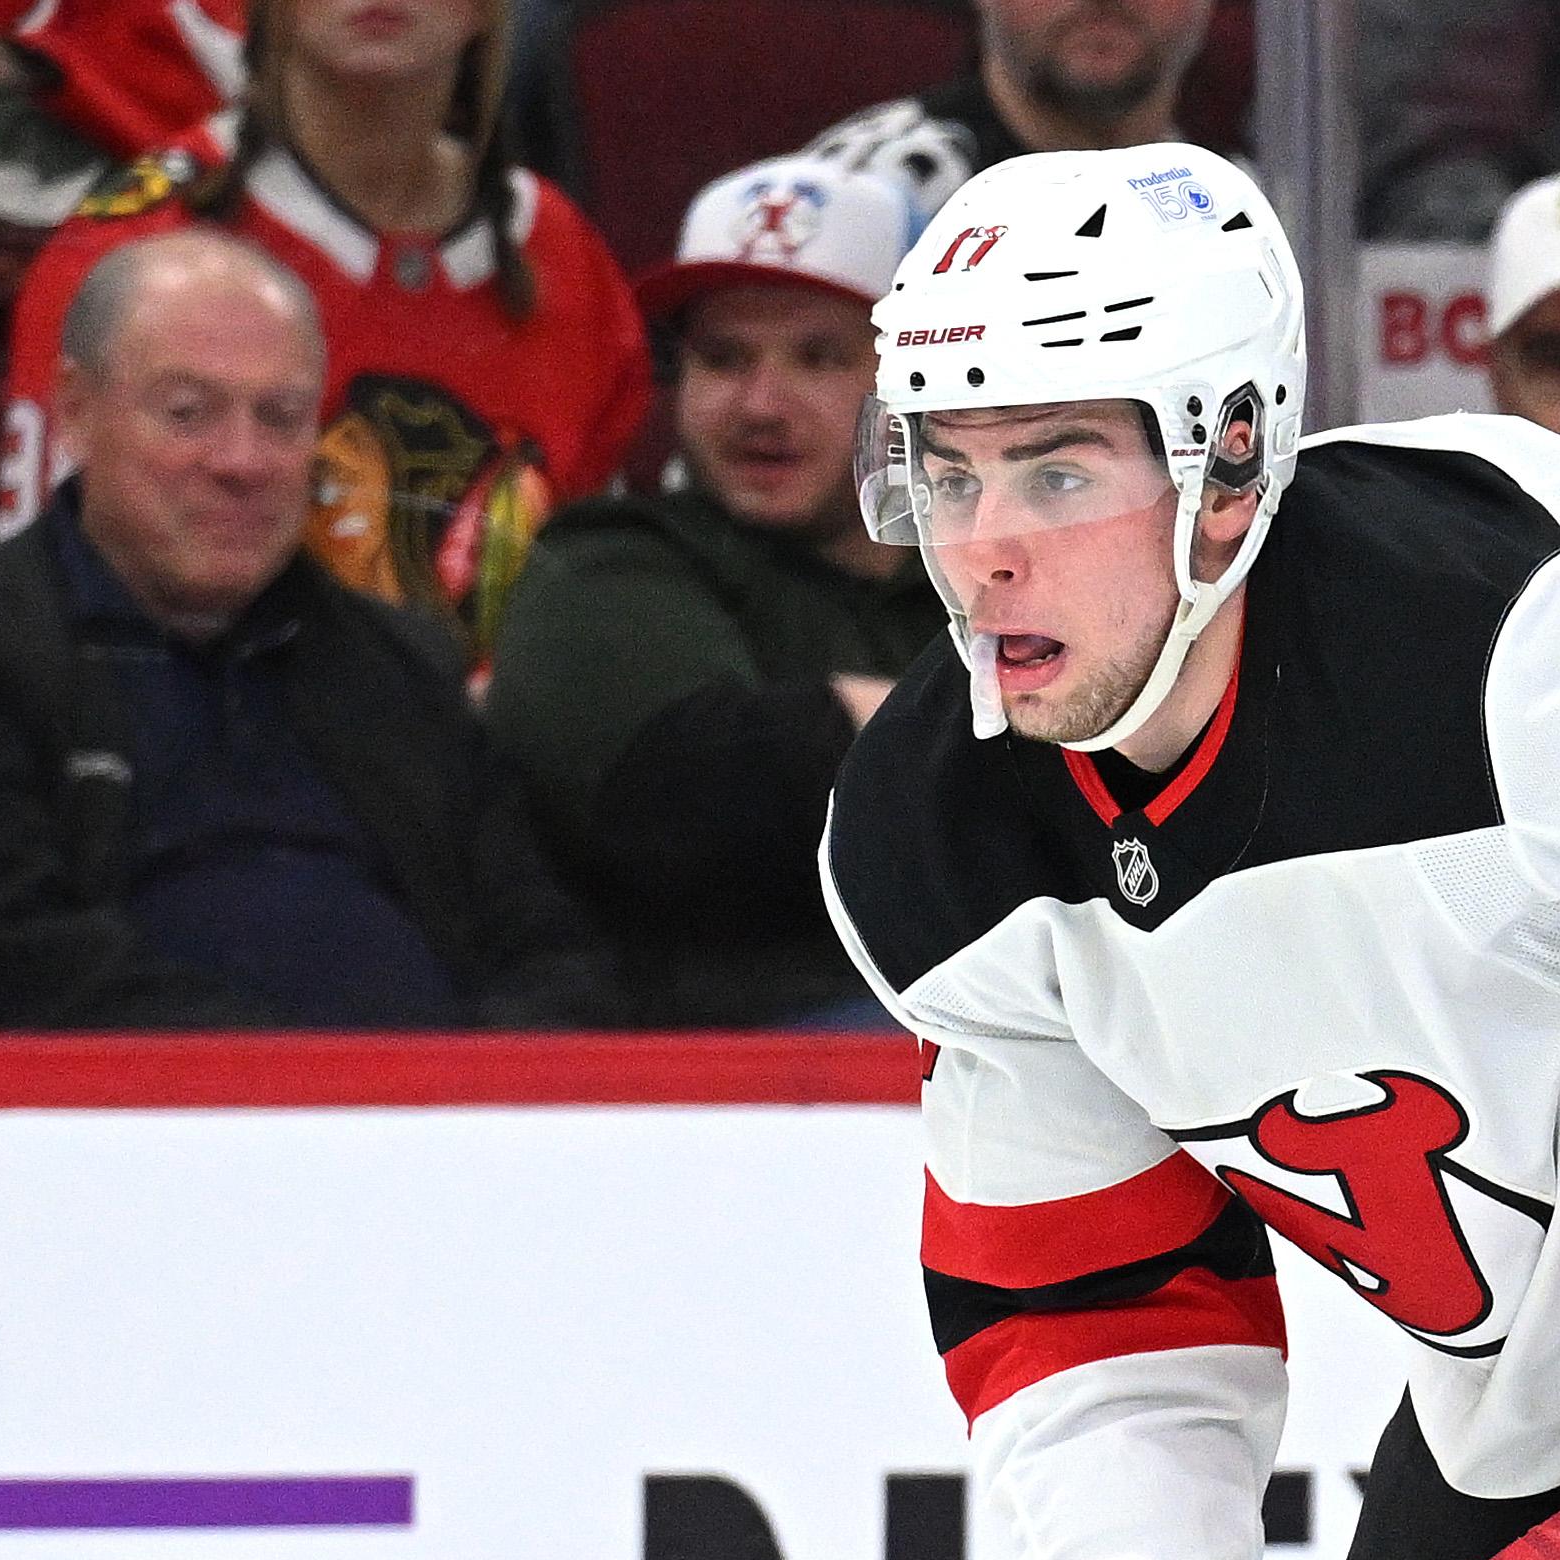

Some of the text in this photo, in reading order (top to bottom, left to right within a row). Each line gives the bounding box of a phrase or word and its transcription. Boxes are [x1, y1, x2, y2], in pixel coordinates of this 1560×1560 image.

[897, 325, 986, 347] BAUER
[1171, 448, 1205, 456] BAUER
[1127, 855, 1145, 892] NHL
